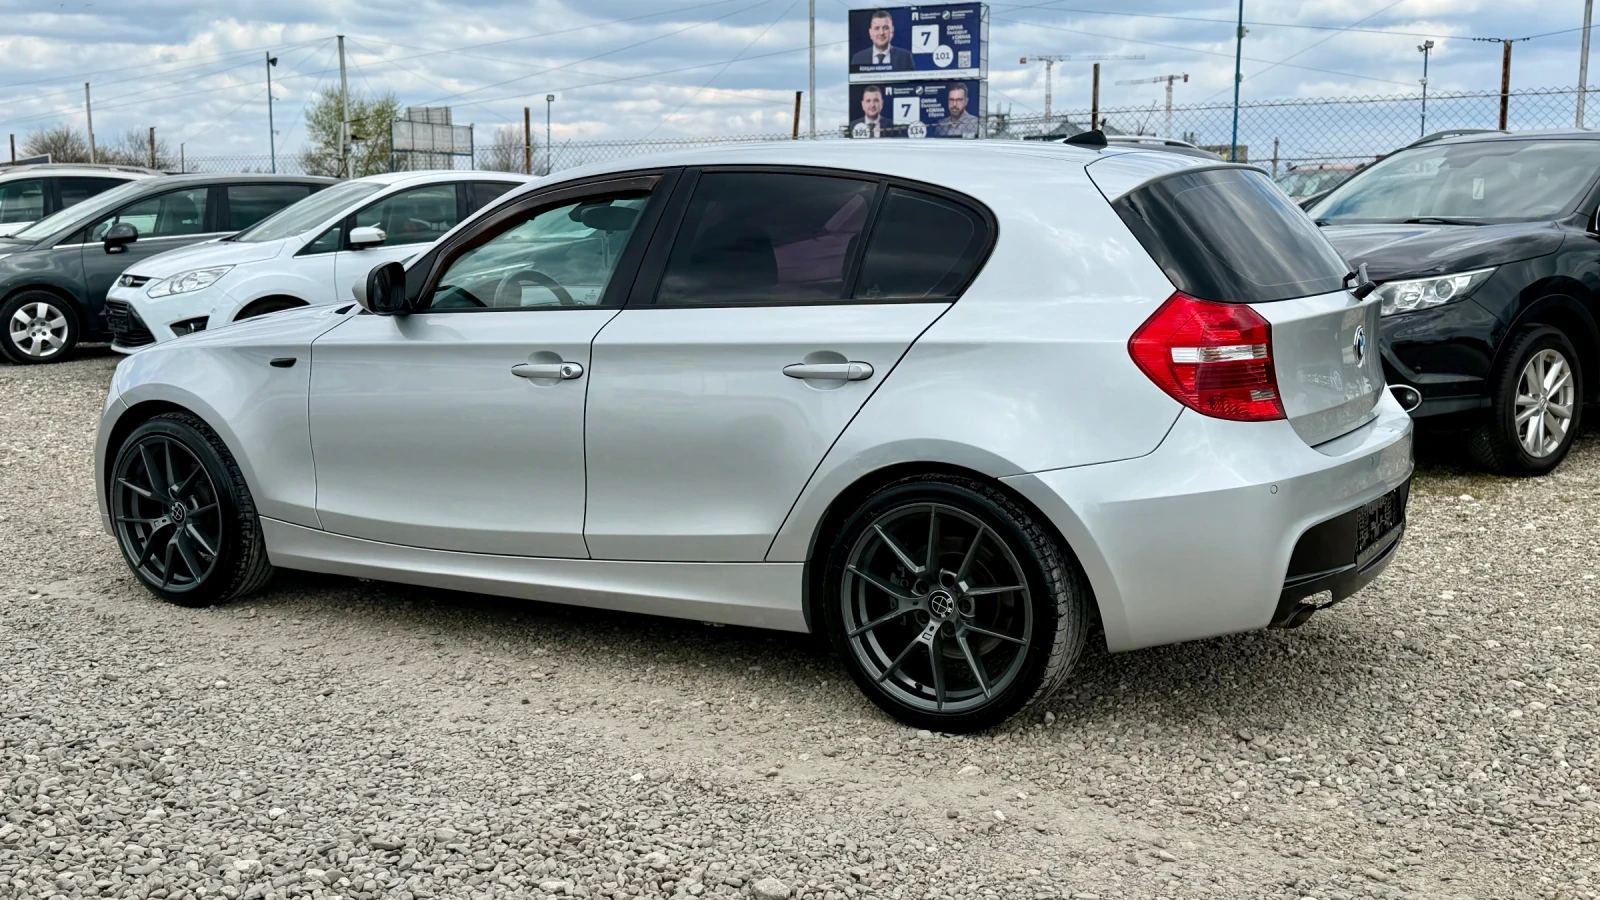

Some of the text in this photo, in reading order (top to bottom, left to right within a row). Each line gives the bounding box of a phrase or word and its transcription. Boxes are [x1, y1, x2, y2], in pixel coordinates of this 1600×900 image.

[921, 31, 931, 46] 7
[935, 52, 951, 60] 101
[901, 103, 911, 118] 7
